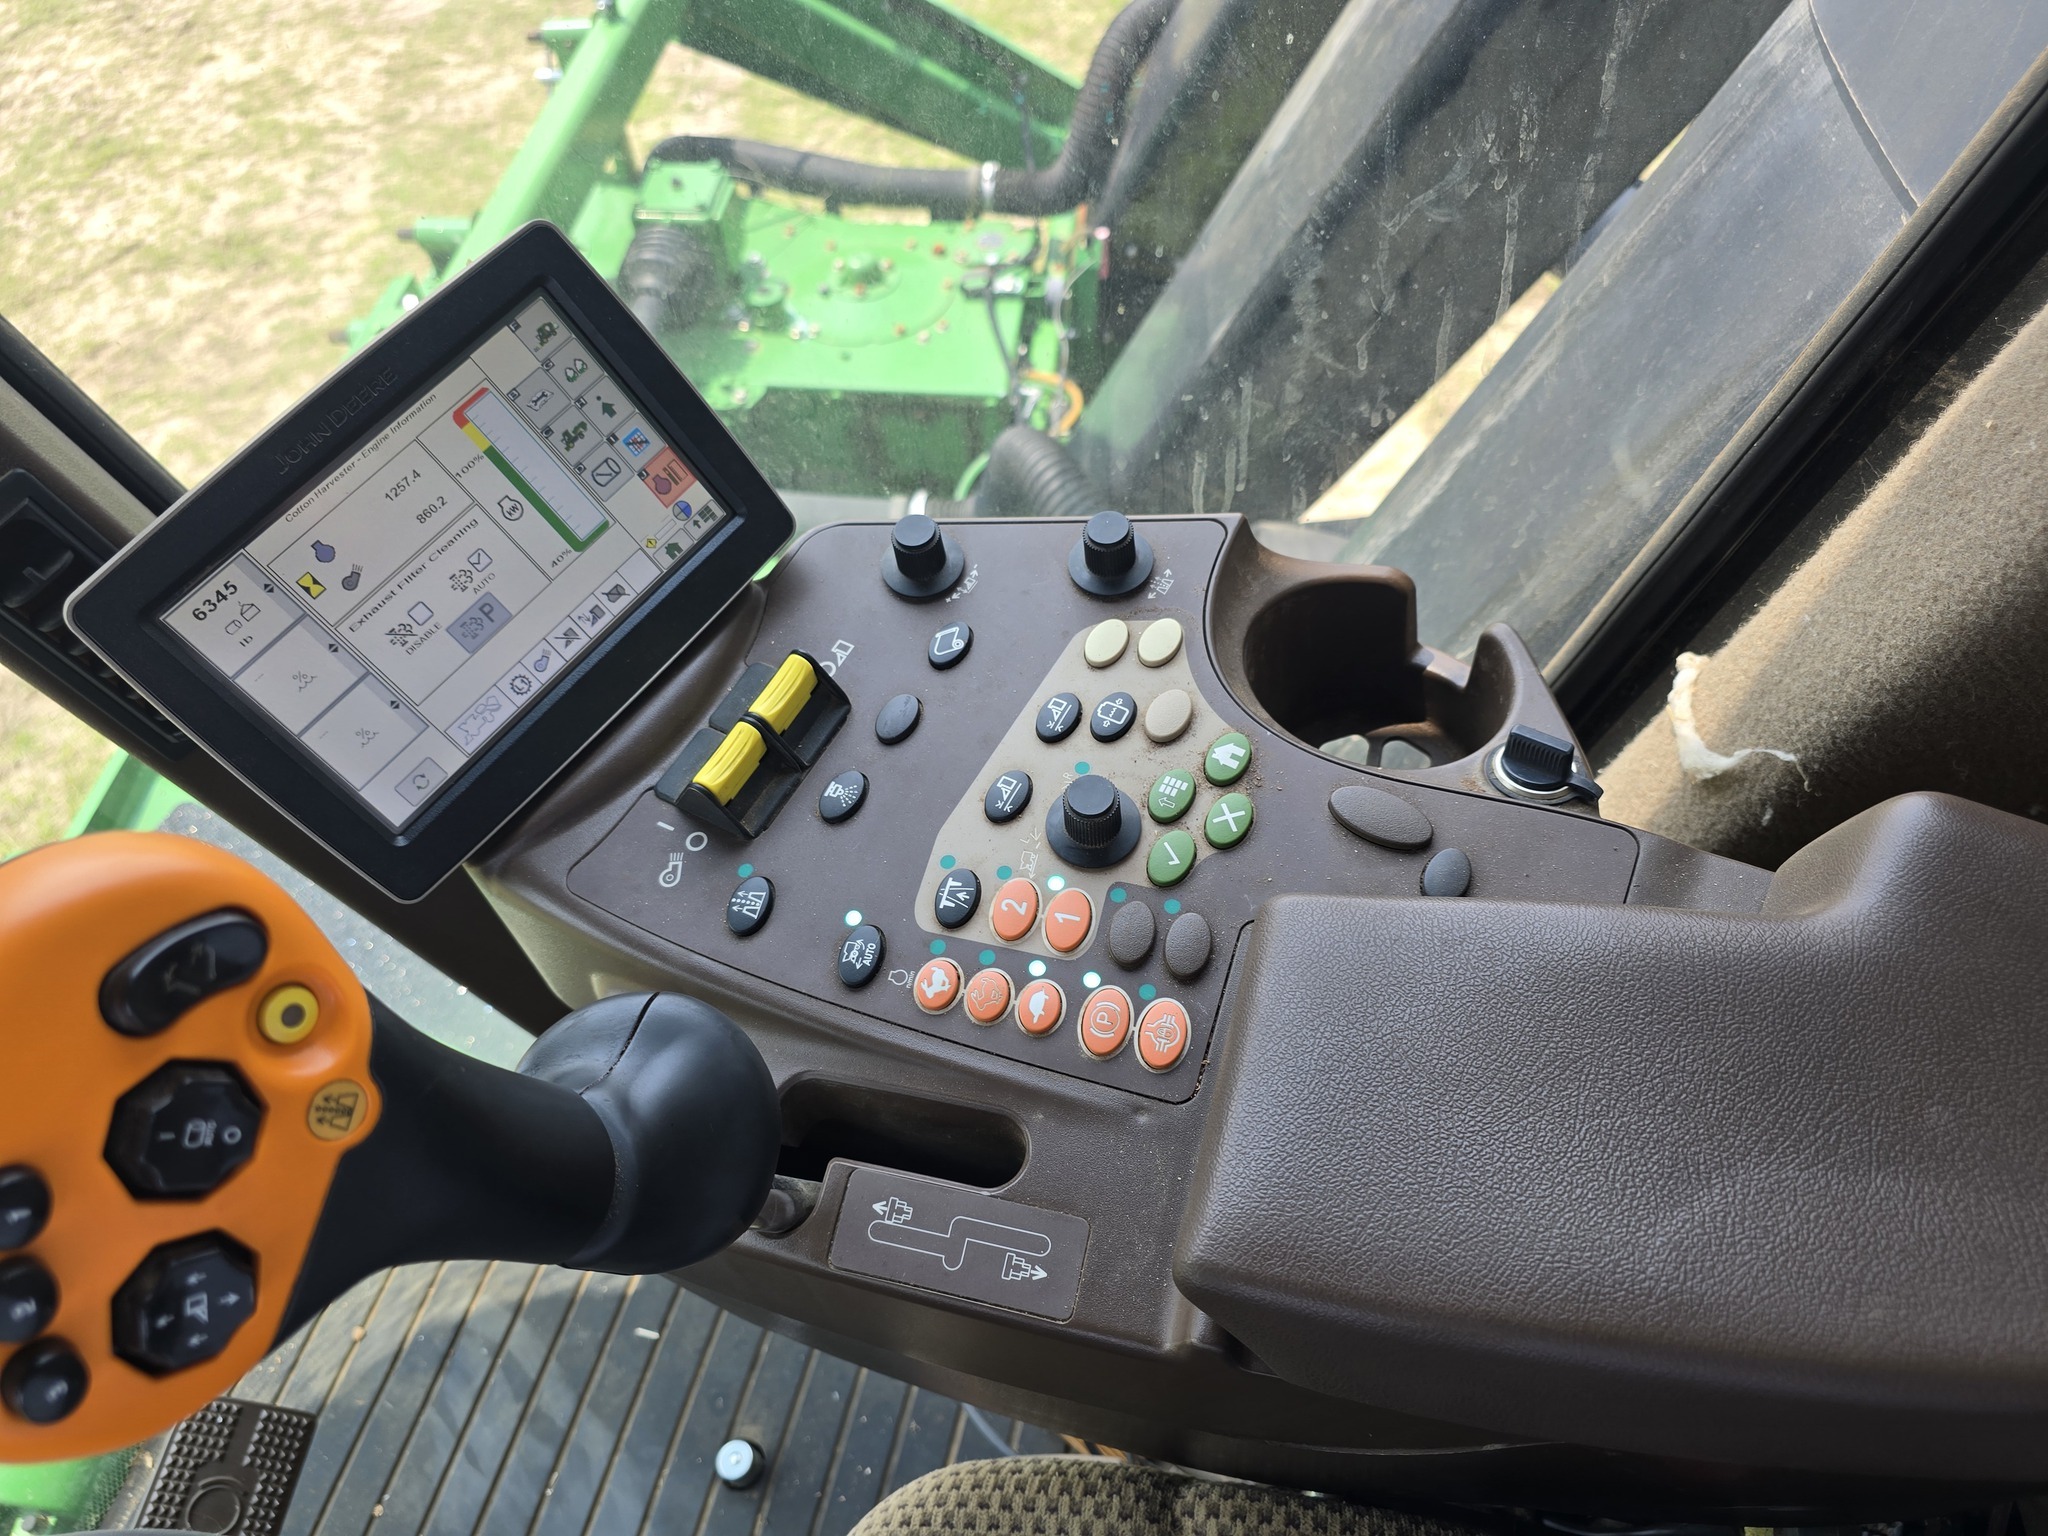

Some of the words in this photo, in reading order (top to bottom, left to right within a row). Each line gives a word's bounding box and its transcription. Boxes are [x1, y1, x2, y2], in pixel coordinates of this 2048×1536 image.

[275, 421, 332, 475] JOHN
[326, 368, 398, 428] DEERE
[285, 495, 315, 523] Cotton
[314, 461, 356, 499] Harvester
[361, 433, 390, 459] Engine
[390, 393, 437, 435] Information
[455, 453, 485, 479] 100%
[385, 469, 422, 502] 1257.4
[416, 495, 448, 525] 860.2
[551, 548, 573, 568] 40%
[348, 589, 400, 633] Exhaust
[397, 563, 428, 590] Filter
[428, 518, 479, 562] Cleaning
[472, 572, 496, 595] AUTO
[192, 580, 238, 621] 6345
[405, 621, 443, 656] DISABLE
[1001, 898, 1028, 916] 2
[1054, 911, 1081, 924] 1
[863, 943, 876, 967] AUTO
[1096, 1011, 1114, 1026] P
